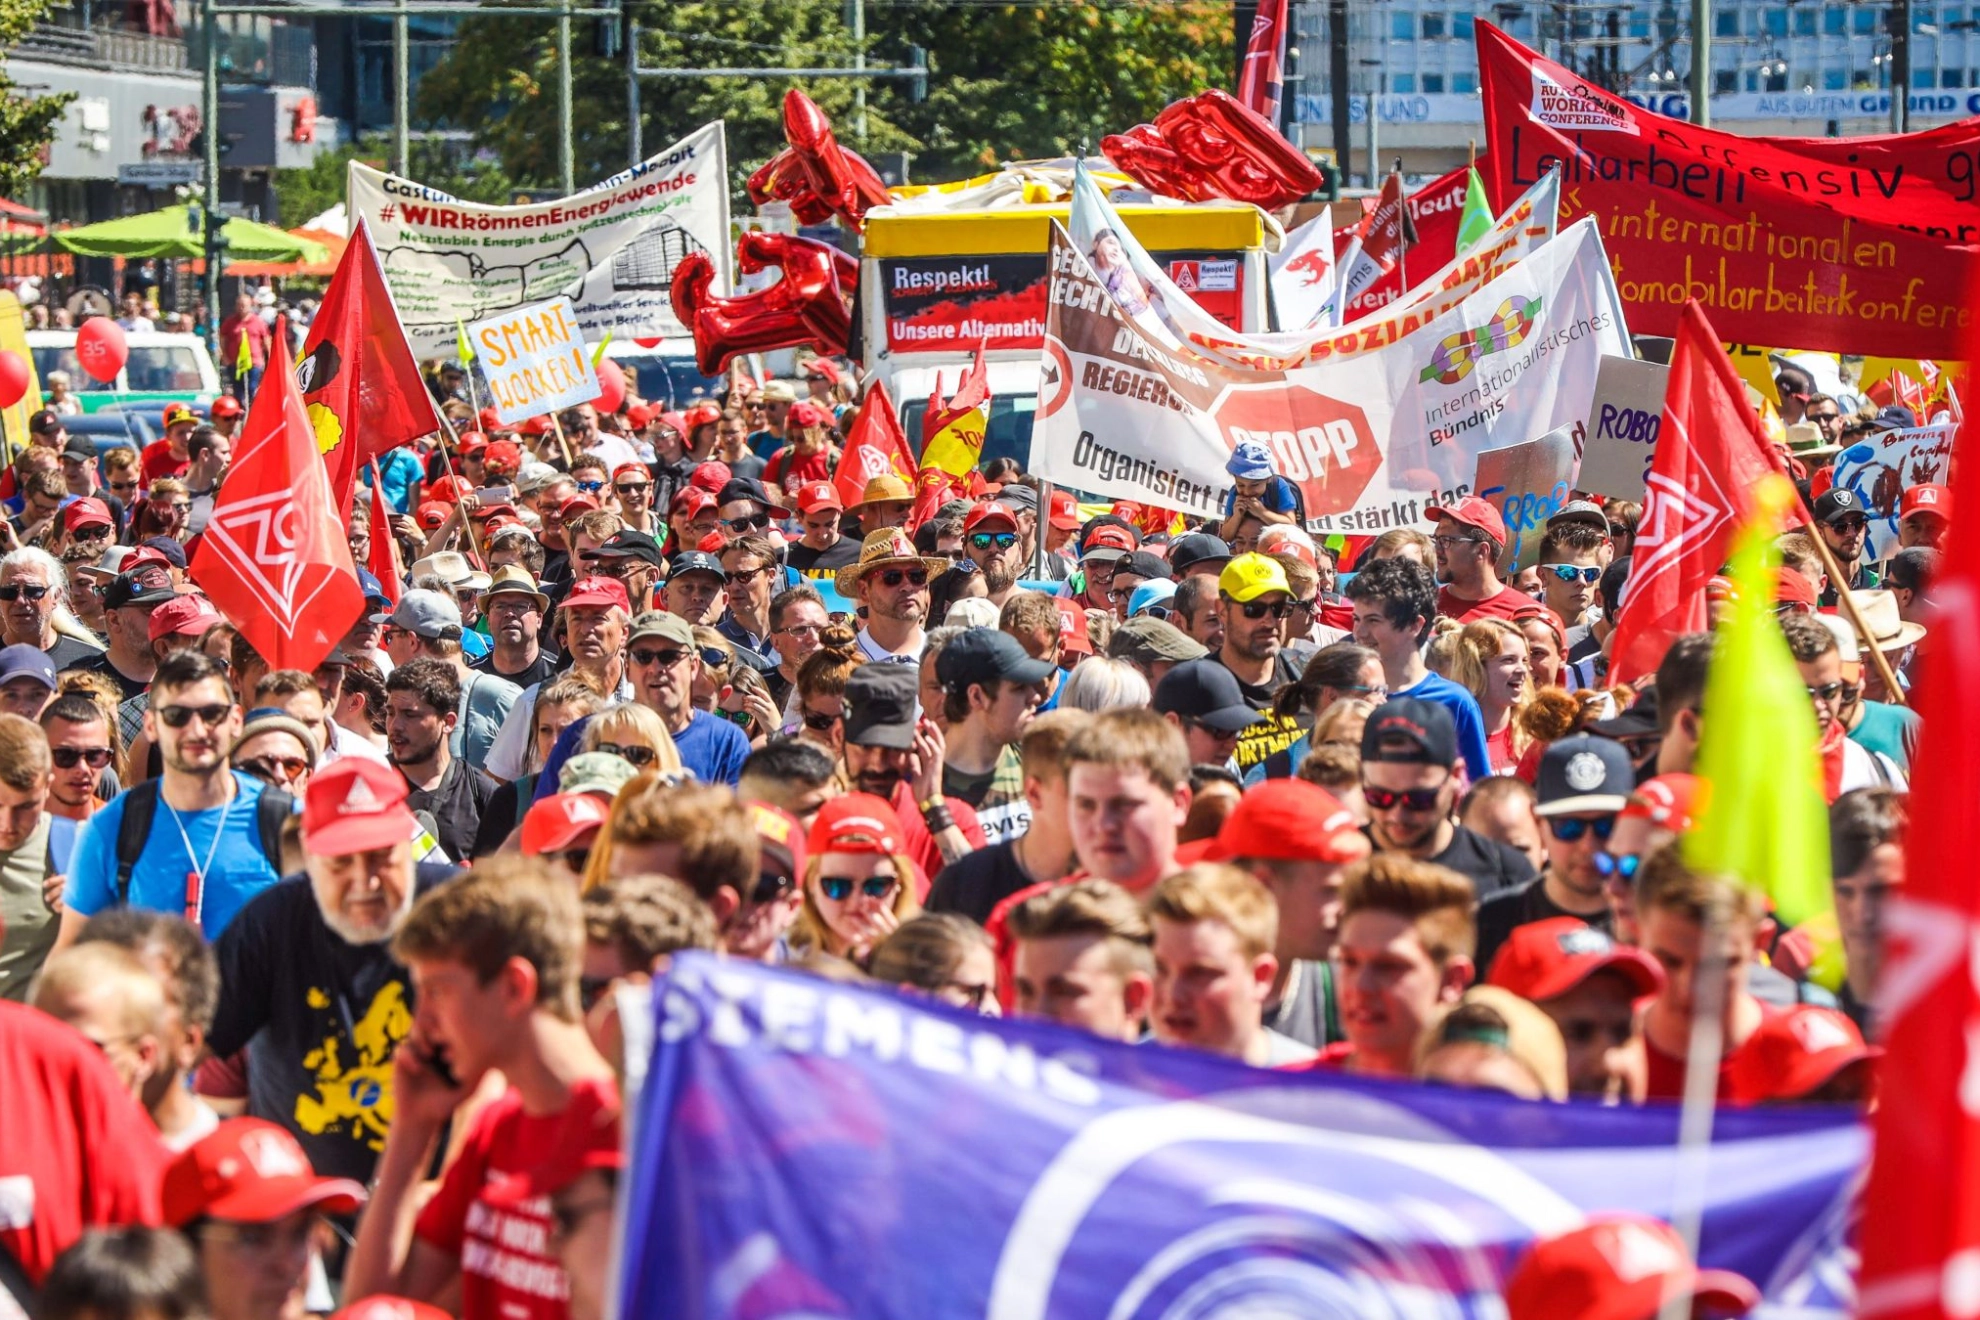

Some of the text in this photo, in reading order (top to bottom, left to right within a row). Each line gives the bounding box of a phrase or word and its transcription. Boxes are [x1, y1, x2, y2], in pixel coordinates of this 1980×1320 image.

[1538, 112, 1629, 129] CONFERENCE
[1946, 150, 1980, 202] g
[483, 236, 535, 248] Energie
[538, 228, 575, 245] durch
[1608, 198, 1896, 268] internationalen
[894, 264, 989, 292] Respekt!
[1201, 264, 1235, 275] Respekt!
[892, 321, 956, 340] Unsere
[490, 347, 589, 410] WORKER!
[1425, 312, 1612, 424] Internationalistisches
[1429, 397, 1505, 447] Bündnis
[1073, 430, 1214, 505] Organisiert
[1340, 500, 1418, 531] stärkt
